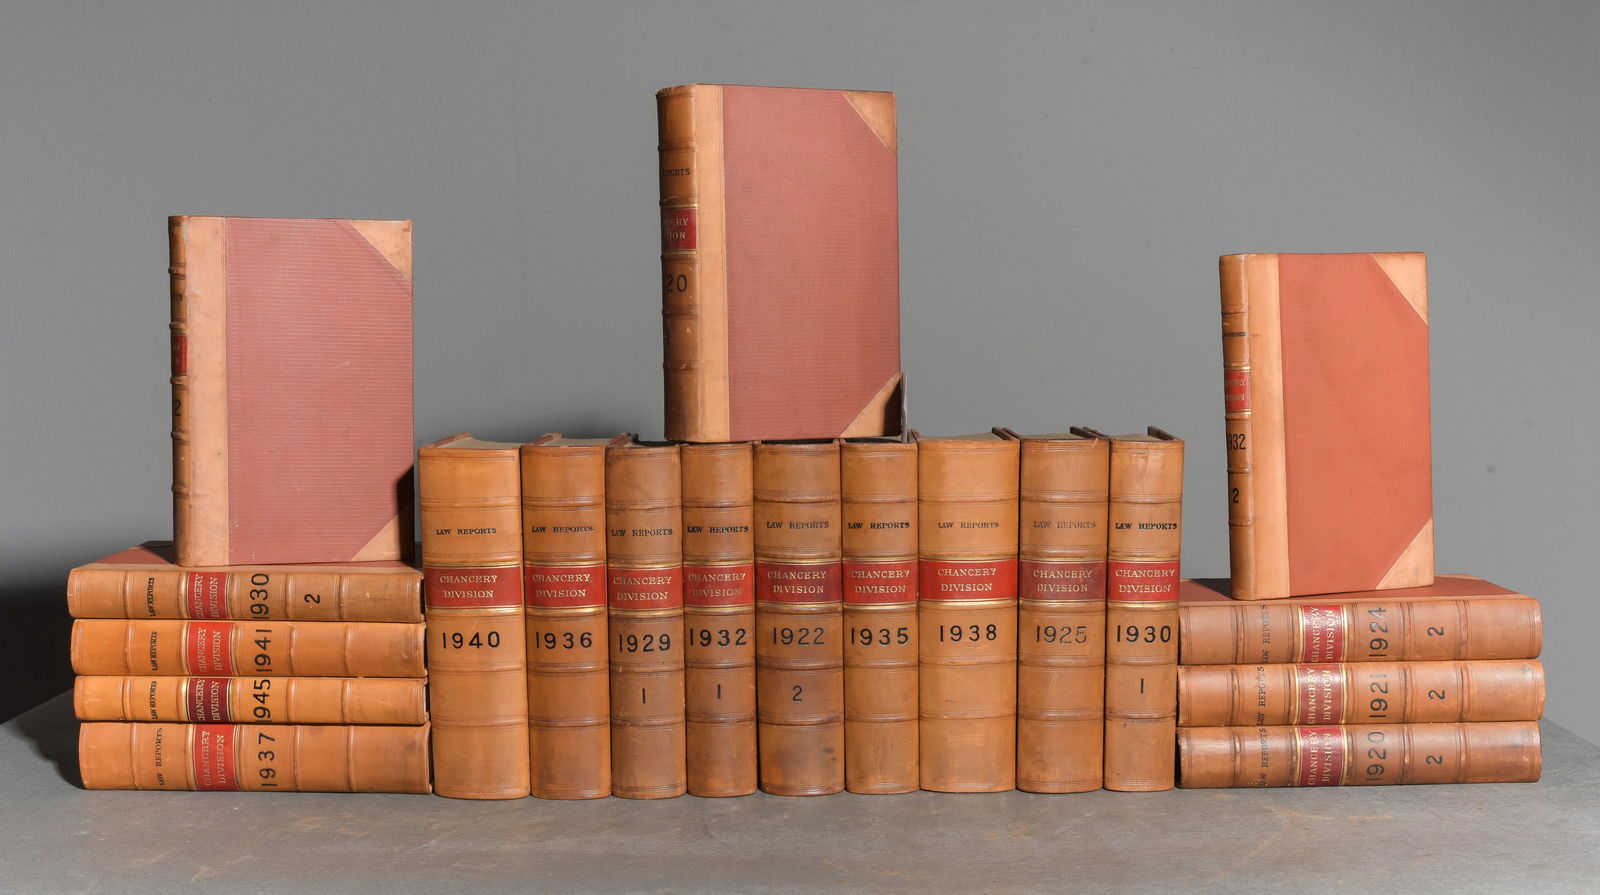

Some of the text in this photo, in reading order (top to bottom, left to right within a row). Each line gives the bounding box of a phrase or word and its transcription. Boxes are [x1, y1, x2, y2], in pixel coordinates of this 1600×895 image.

[664, 274, 688, 292] 20
[1227, 433, 1247, 450] 932
[1232, 487, 1240, 504] 2
[436, 527, 497, 536] LAW REPORTS
[552, 525, 594, 533] REPORTS
[611, 528, 673, 537] LAW REPORTS
[687, 525, 749, 533] LAW REPORTS
[766, 521, 830, 529] LAW REPORTS
[870, 521, 910, 529] REPORTS
[938, 521, 1000, 529] LAW REPORTS
[1033, 521, 1097, 529] LAW REPORTS
[1115, 522, 1178, 530] LAW REPORTS
[440, 575, 498, 583] CHANCERY
[532, 573, 591, 582] CHANCERY
[613, 576, 673, 585] CHANCERY
[688, 573, 747, 582] CHANCERY
[767, 571, 828, 580] CHANCERY
[851, 569, 911, 578] CHANCERY
[937, 568, 997, 576] CHANCERY
[1033, 570, 1093, 579] CHANCERY
[1115, 569, 1176, 578] CHANCERY
[249, 573, 270, 619] 1930
[443, 590, 494, 598] DIVISION
[536, 589, 586, 597] DIVISION
[616, 592, 668, 600] DIVISION
[692, 588, 742, 597] DIVISION
[773, 585, 825, 593] DIVISION
[854, 585, 906, 593] DIVISION
[941, 583, 993, 592] DIVISION
[1037, 584, 1088, 593] DIVISION
[1118, 584, 1172, 593] DIVISION
[210, 576, 219, 618] DIVISION
[304, 593, 321, 605] 2
[689, 628, 747, 647] 1932
[772, 627, 825, 646] 1922
[850, 627, 909, 646] 1935
[939, 624, 997, 643] 1938
[1035, 625, 1087, 644] 1925
[1116, 624, 1172, 643] 1930
[1310, 607, 1320, 663] CHANCERY
[1325, 610, 1335, 660] DIVISION
[1368, 607, 1389, 657] 1924
[1427, 626, 1444, 636] 2
[442, 631, 501, 649] 1940
[535, 631, 593, 649] 1936
[618, 634, 671, 653] 1929
[212, 629, 222, 672] DIVISION
[254, 628, 272, 673] 1941
[210, 680, 221, 721] DIVISION
[252, 679, 273, 723] 1945
[792, 685, 803, 702] 2
[1306, 667, 1317, 725] CHANCERY
[1323, 669, 1332, 720] DIVISION
[1369, 673, 1389, 718] 1921
[1428, 689, 1445, 700] 2
[155, 727, 165, 786] LAW REPORTS
[202, 730, 212, 786] CHANCERY
[216, 734, 226, 784] DIVISION
[258, 732, 278, 787] 1937
[1308, 730, 1319, 786] CHANCERY
[1322, 733, 1333, 782] DIVISION
[1366, 731, 1387, 781] 1920
[1426, 754, 1443, 765] 2
